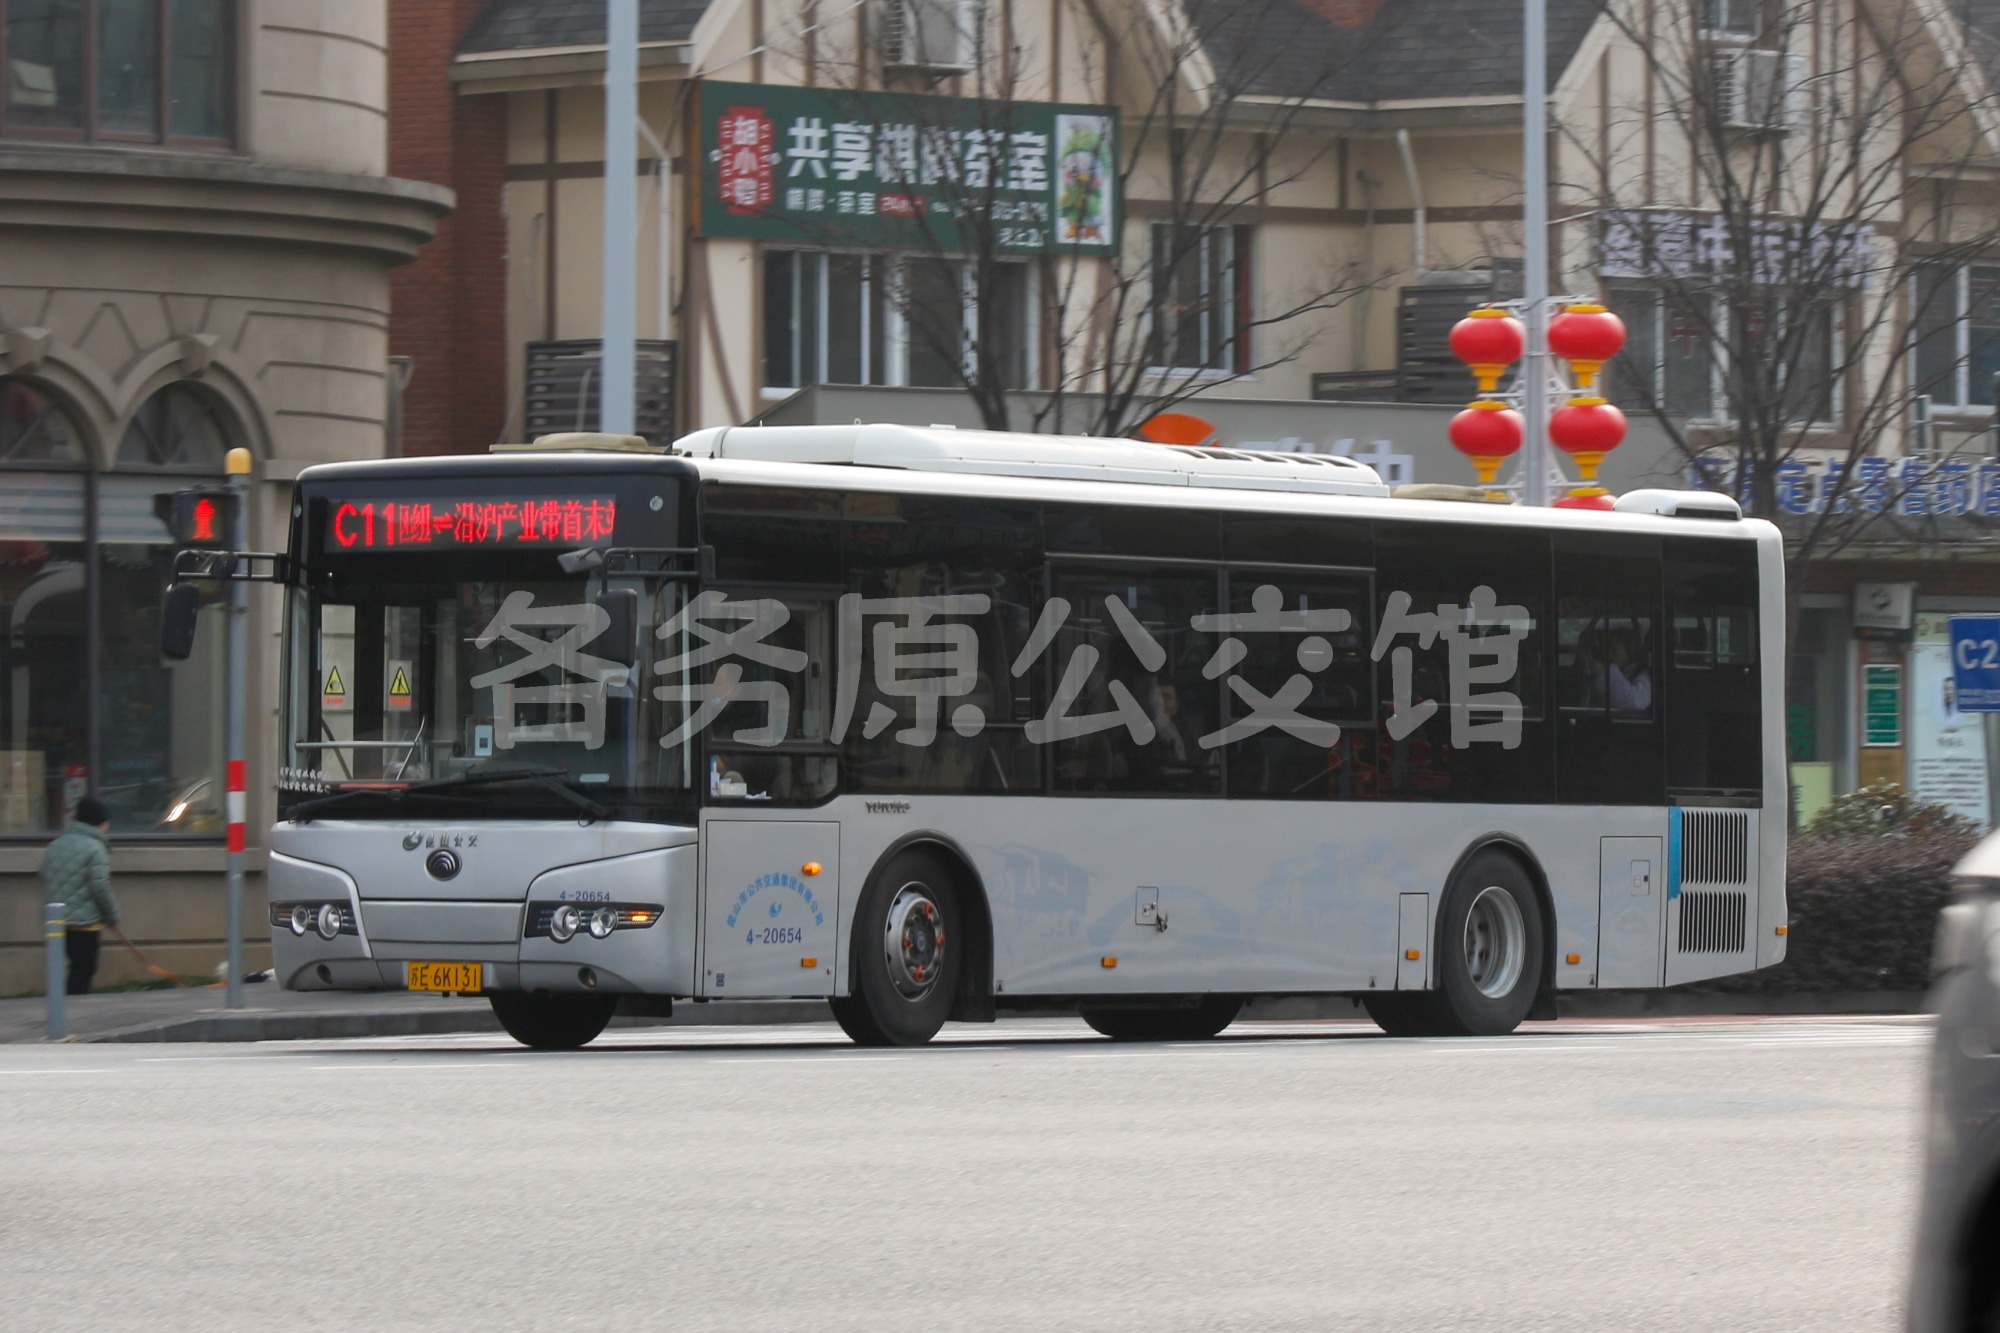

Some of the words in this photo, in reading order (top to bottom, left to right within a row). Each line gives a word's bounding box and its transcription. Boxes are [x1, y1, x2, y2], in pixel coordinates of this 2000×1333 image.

[334, 502, 395, 547] C11
[559, 890, 610, 902] 4-20654
[746, 927, 802, 945] 4-20654
